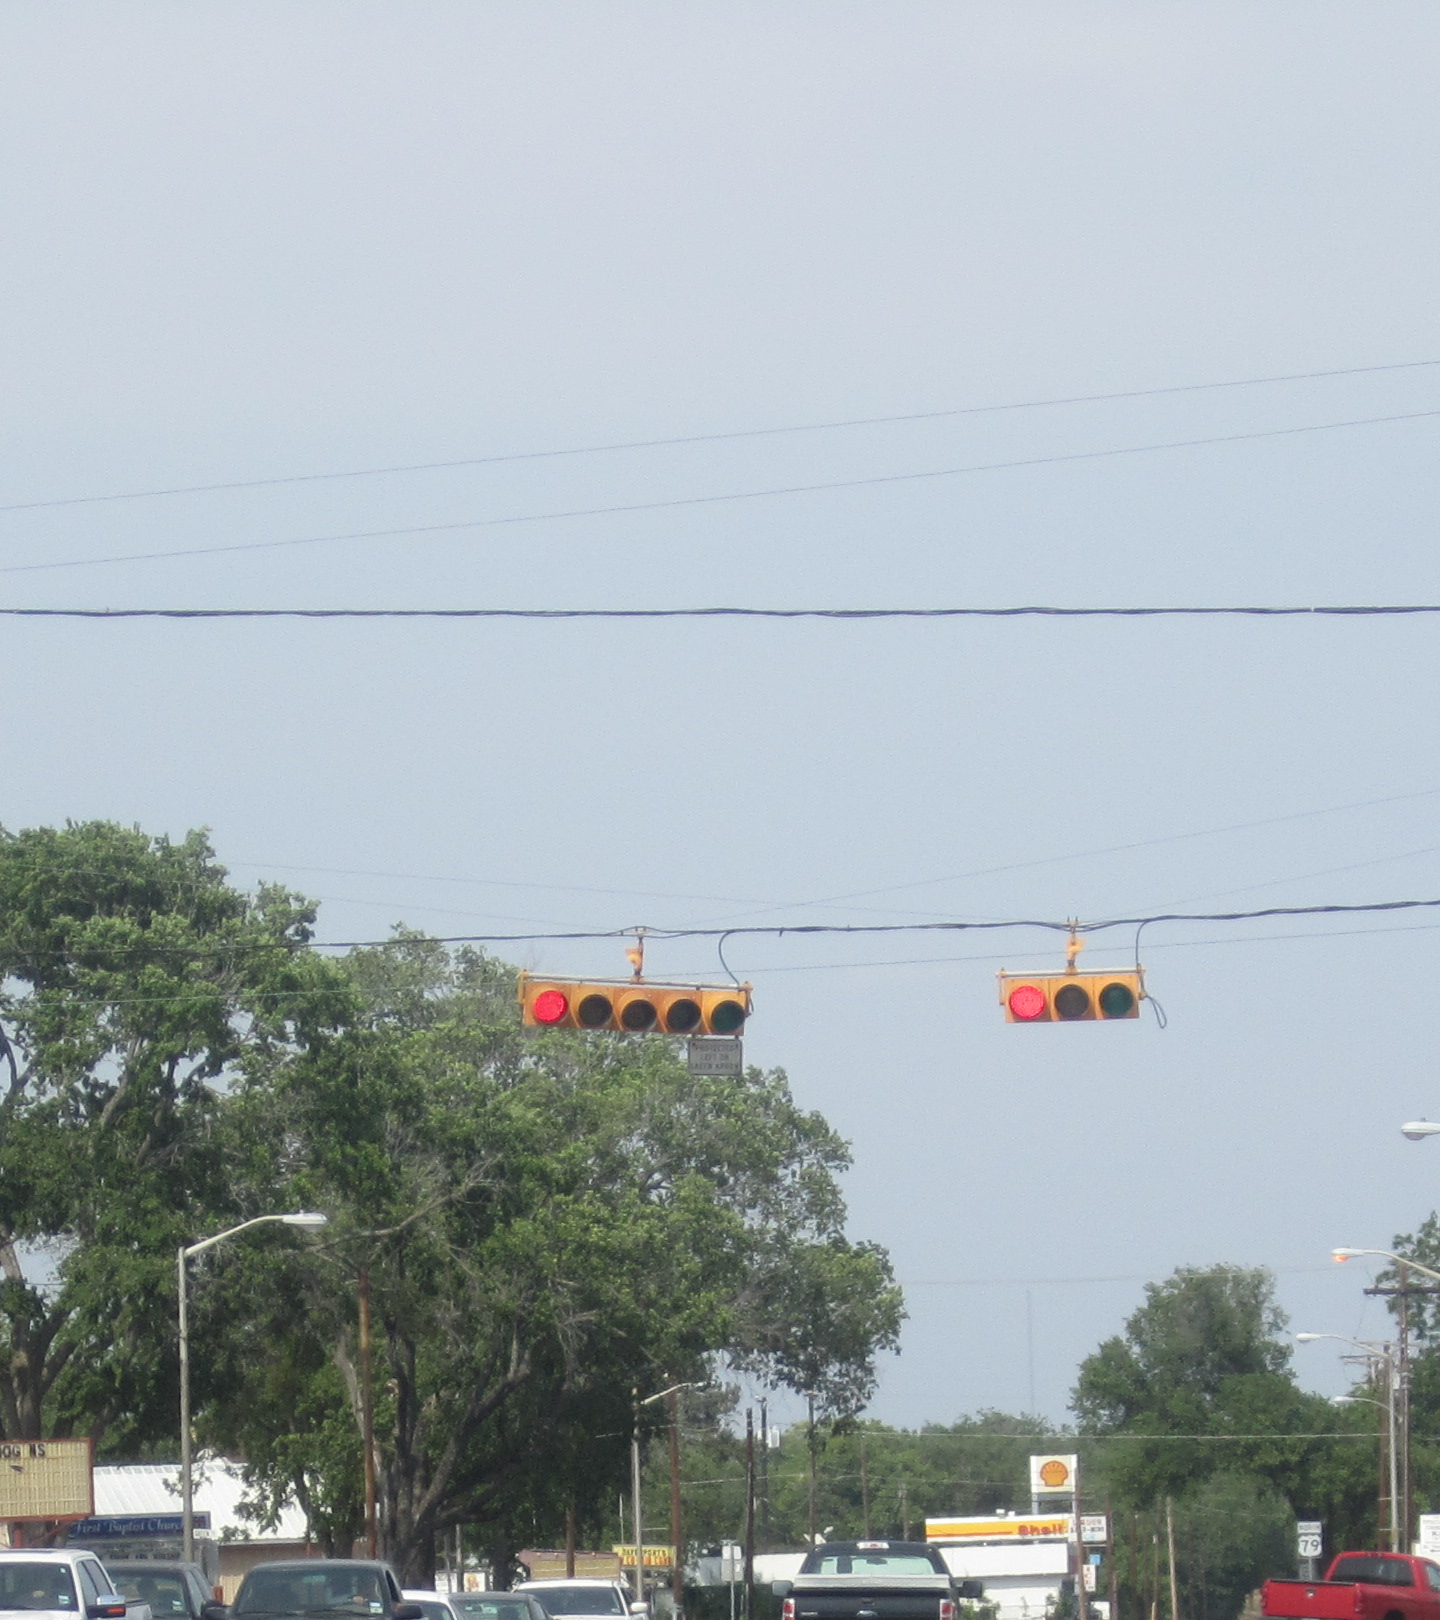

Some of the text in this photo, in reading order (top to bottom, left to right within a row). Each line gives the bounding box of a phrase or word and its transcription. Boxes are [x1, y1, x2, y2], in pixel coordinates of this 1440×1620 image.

[75, 1521, 101, 1535] First
[108, 1519, 145, 1535] Baptist
[1018, 1523, 1062, 1536] Shell
[1300, 1539, 1320, 1553] 79
